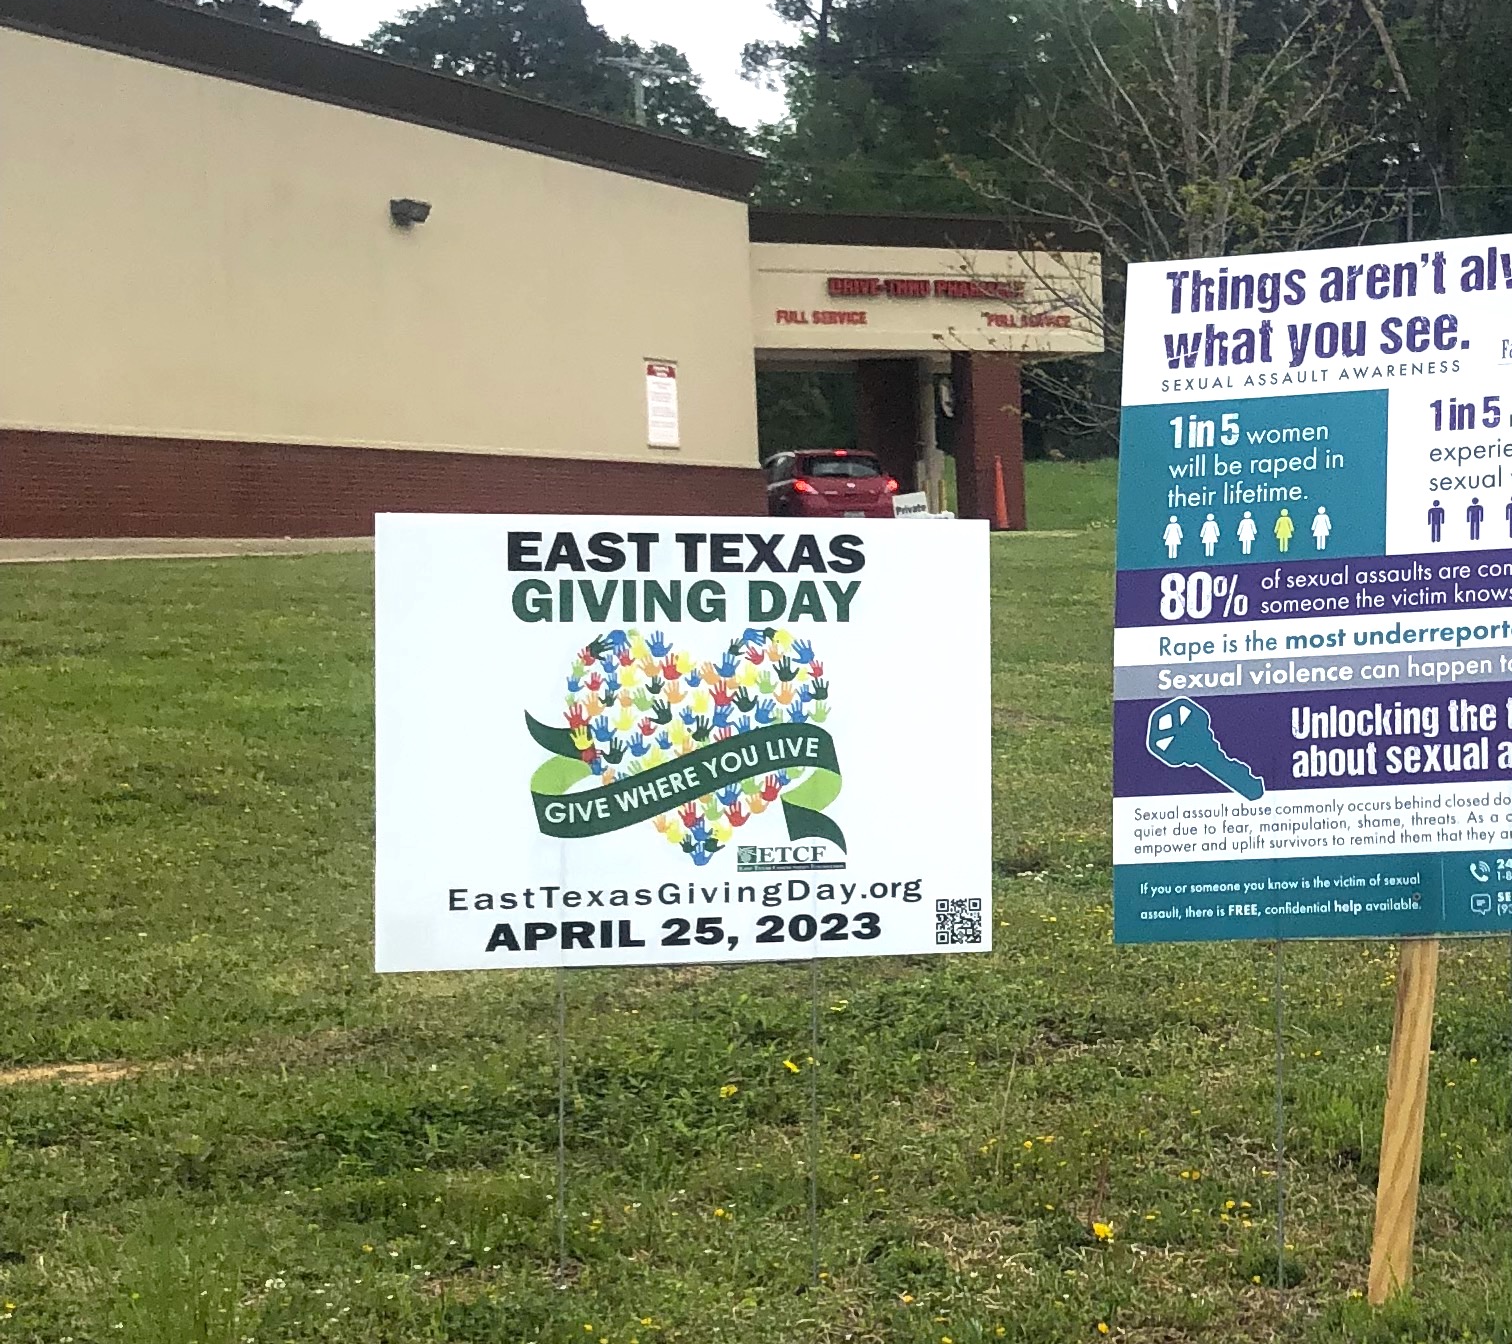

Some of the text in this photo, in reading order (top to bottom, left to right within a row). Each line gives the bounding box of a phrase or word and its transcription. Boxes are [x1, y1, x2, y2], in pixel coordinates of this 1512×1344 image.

[934, 280, 1026, 298] PHAR
[1166, 269, 1306, 315] Things
[1319, 251, 1446, 303] aren't
[776, 310, 808, 325] FULL
[1164, 312, 1471, 369] what you see.
[1161, 359, 1462, 393] SEXUAL ASSAULT AWARENESS
[1247, 422, 1329, 444] women
[1168, 447, 1344, 483] will be raped in
[1429, 469, 1501, 491] sexual
[897, 504, 926, 514] Private
[1167, 479, 1309, 508] their lifetime.
[506, 532, 866, 573] EAST TEXAS
[511, 579, 863, 624] GIVING DAY
[1159, 571, 1248, 621] 80%
[1261, 569, 1282, 590] of
[1286, 566, 1349, 589] sexual
[1355, 564, 1433, 584] assaults
[1438, 561, 1470, 580] are
[1159, 635, 1214, 660] Rape
[1222, 634, 1238, 652] is
[1245, 631, 1278, 651] the
[1285, 628, 1346, 649] most
[1158, 665, 1242, 690] Sexual
[1250, 661, 1355, 686] violence
[1360, 661, 1400, 680] can
[1407, 654, 1493, 680] happen
[1291, 701, 1439, 740] Unlocking
[1448, 698, 1498, 733] the
[1292, 744, 1378, 779] about
[1385, 738, 1490, 774] sexual
[544, 737, 819, 826] GIVE WHERE YOU LIVE
[1134, 806, 1178, 821] Sexual
[1183, 804, 1228, 819] assault
[1232, 805, 1271, 817] abuse
[1275, 800, 1344, 816] commonly
[1348, 800, 1391, 811] occurs
[1395, 795, 1440, 809] behind
[1446, 793, 1489, 807] closed
[758, 846, 826, 863] ETCF
[448, 879, 923, 912] EastTexasGivingDay.org
[485, 912, 882, 952] APRIL 25, 2023
